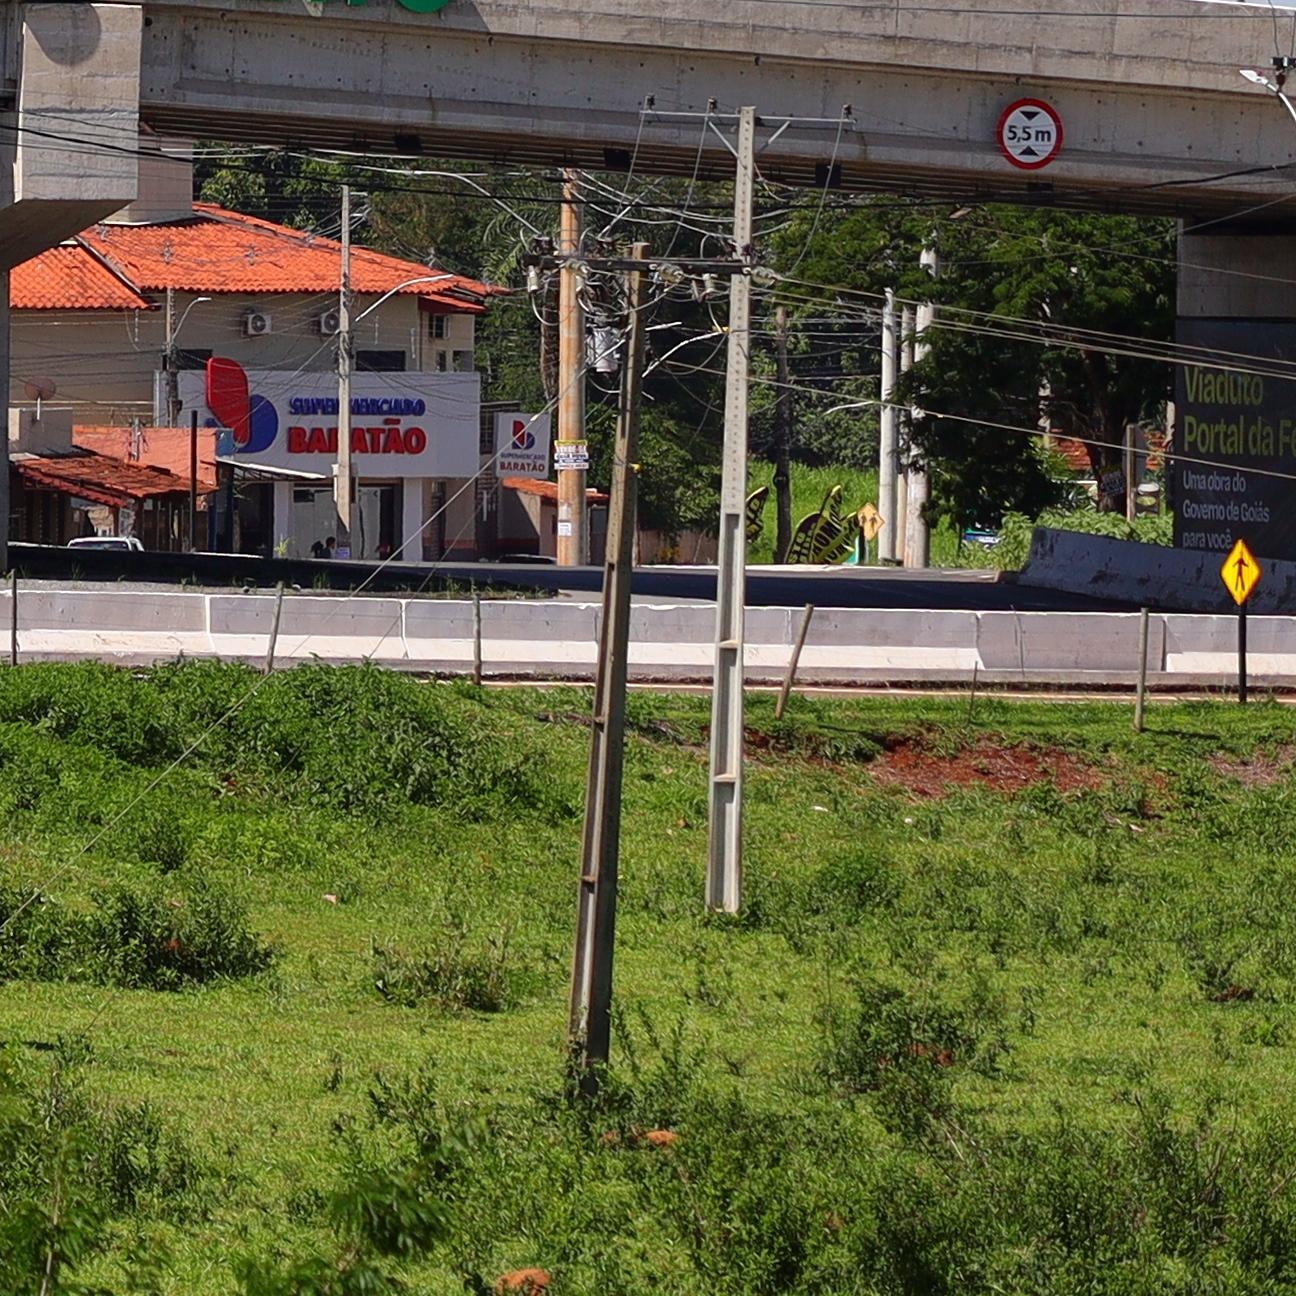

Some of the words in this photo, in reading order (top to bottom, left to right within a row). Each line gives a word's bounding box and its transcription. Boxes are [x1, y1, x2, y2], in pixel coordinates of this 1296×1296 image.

[1007, 125, 1032, 143] 5,5
[1035, 130, 1052, 142] m
[1183, 365, 1264, 406] Viaduto
[1183, 414, 1244, 455] Portal
[1247, 416, 1274, 456] da
[499, 461, 546, 473] BARATÃO
[1182, 469, 1207, 490] Uma
[1207, 470, 1232, 492] obra
[1232, 471, 1247, 493] do
[1182, 498, 1226, 521] Governo
[1226, 500, 1239, 522] de
[1240, 500, 1271, 523] Goiás
[1183, 530, 1206, 549] para
